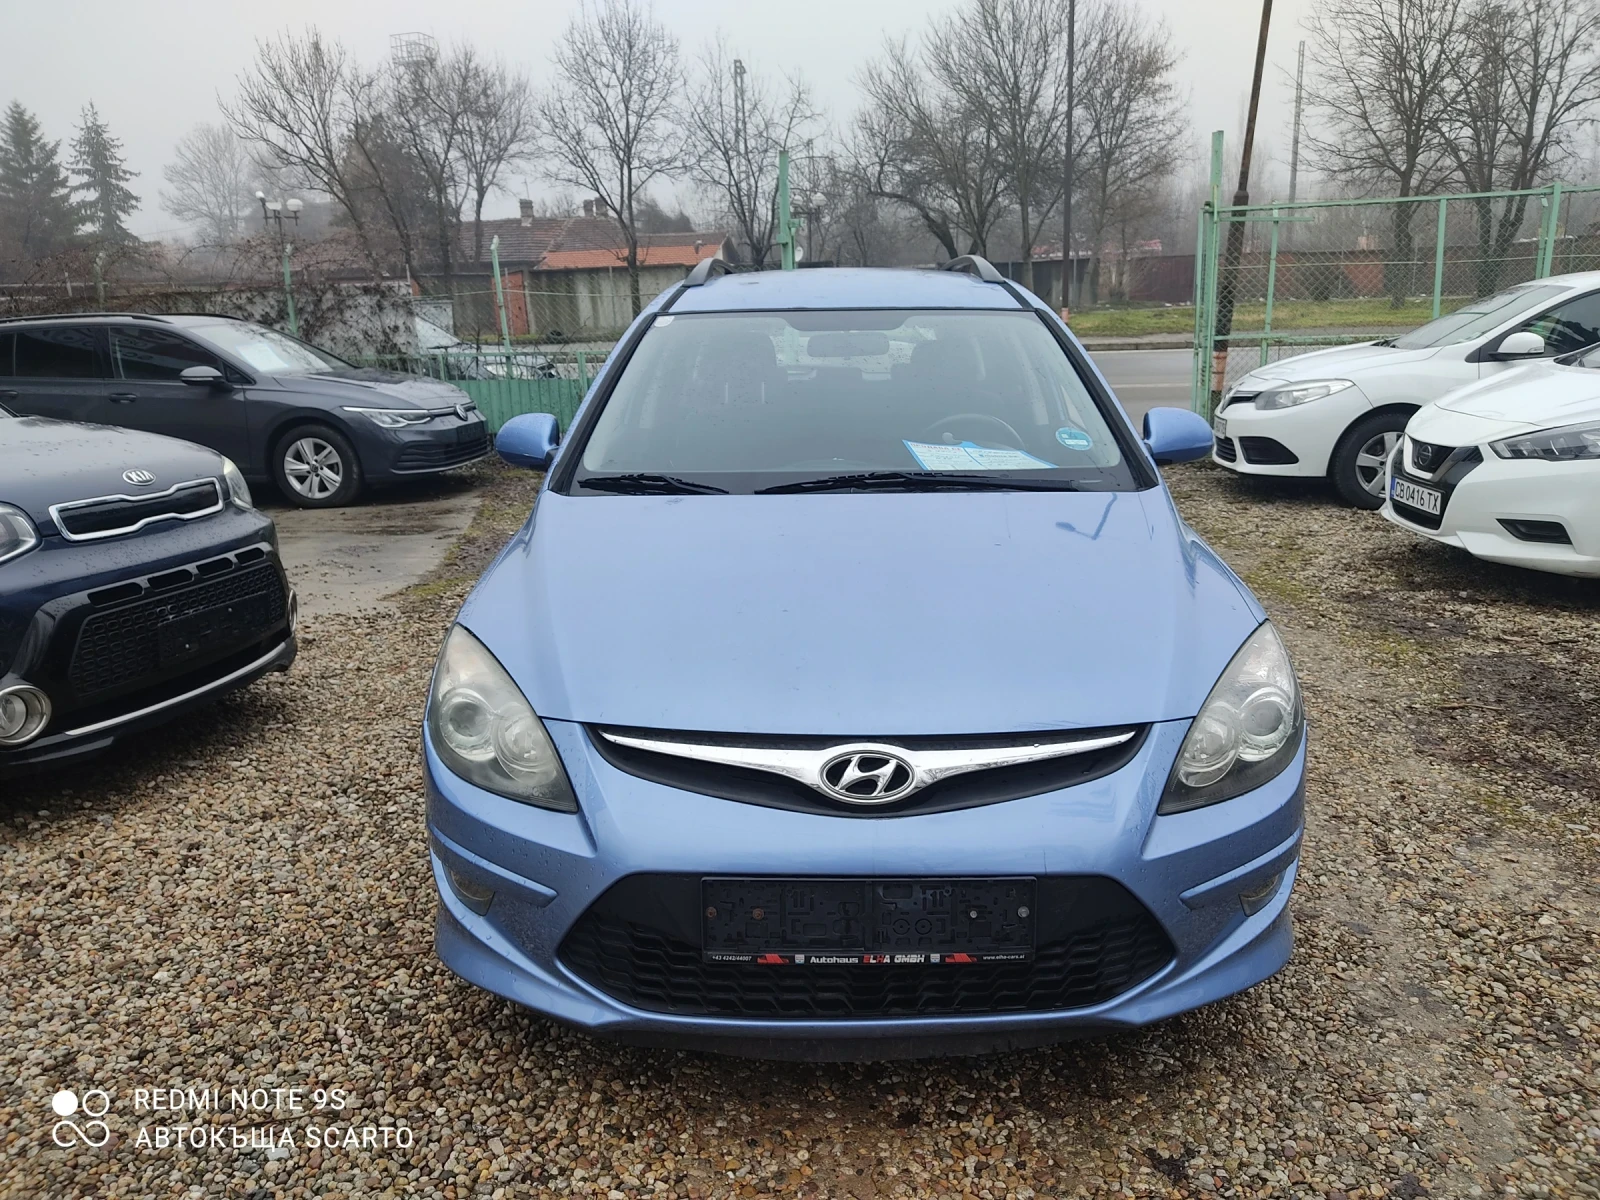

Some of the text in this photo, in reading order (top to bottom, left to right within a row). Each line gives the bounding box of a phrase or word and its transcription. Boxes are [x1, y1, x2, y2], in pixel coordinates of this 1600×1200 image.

[126, 470, 155, 482] KIA
[1395, 480, 1440, 512] CB 0416 TX
[809, 955, 859, 964] Autohaus
[863, 954, 891, 964] ELHA
[893, 954, 925, 963] GMBH
